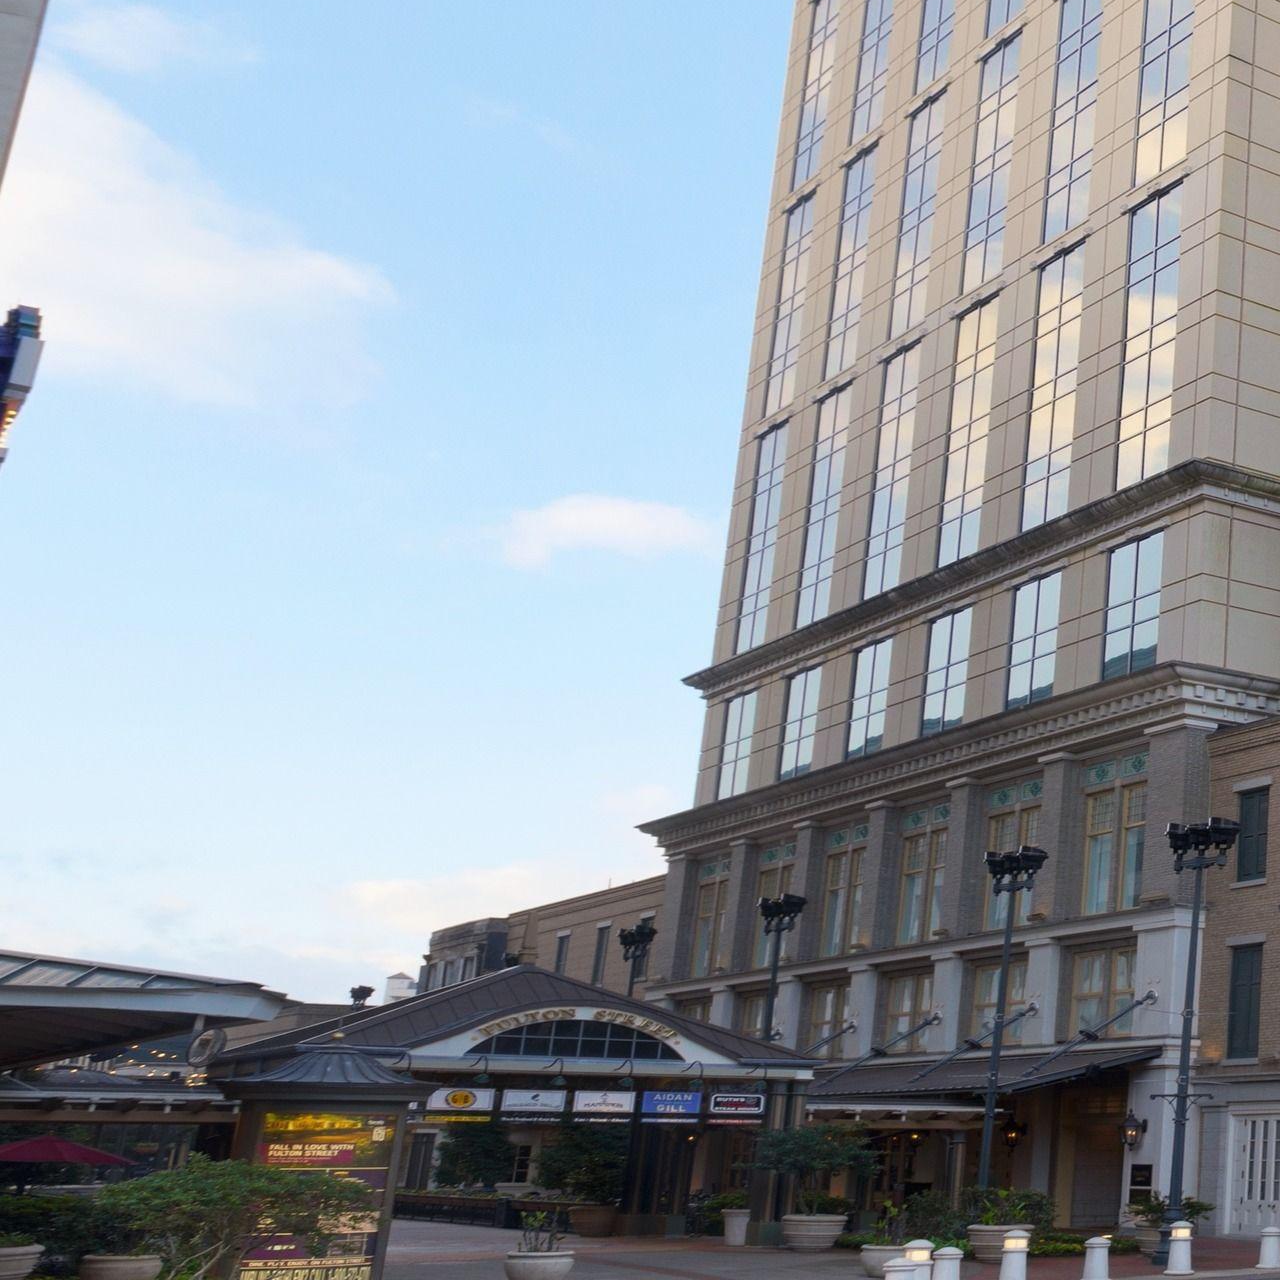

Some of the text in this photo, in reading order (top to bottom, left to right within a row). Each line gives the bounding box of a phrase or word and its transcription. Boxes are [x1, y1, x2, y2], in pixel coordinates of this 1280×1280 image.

[479, 1008, 680, 1040] FULTON STREET
[653, 1093, 693, 1102] AIDAN
[656, 1104, 686, 1113] GILL
[268, 1150, 303, 1158] FULTON
